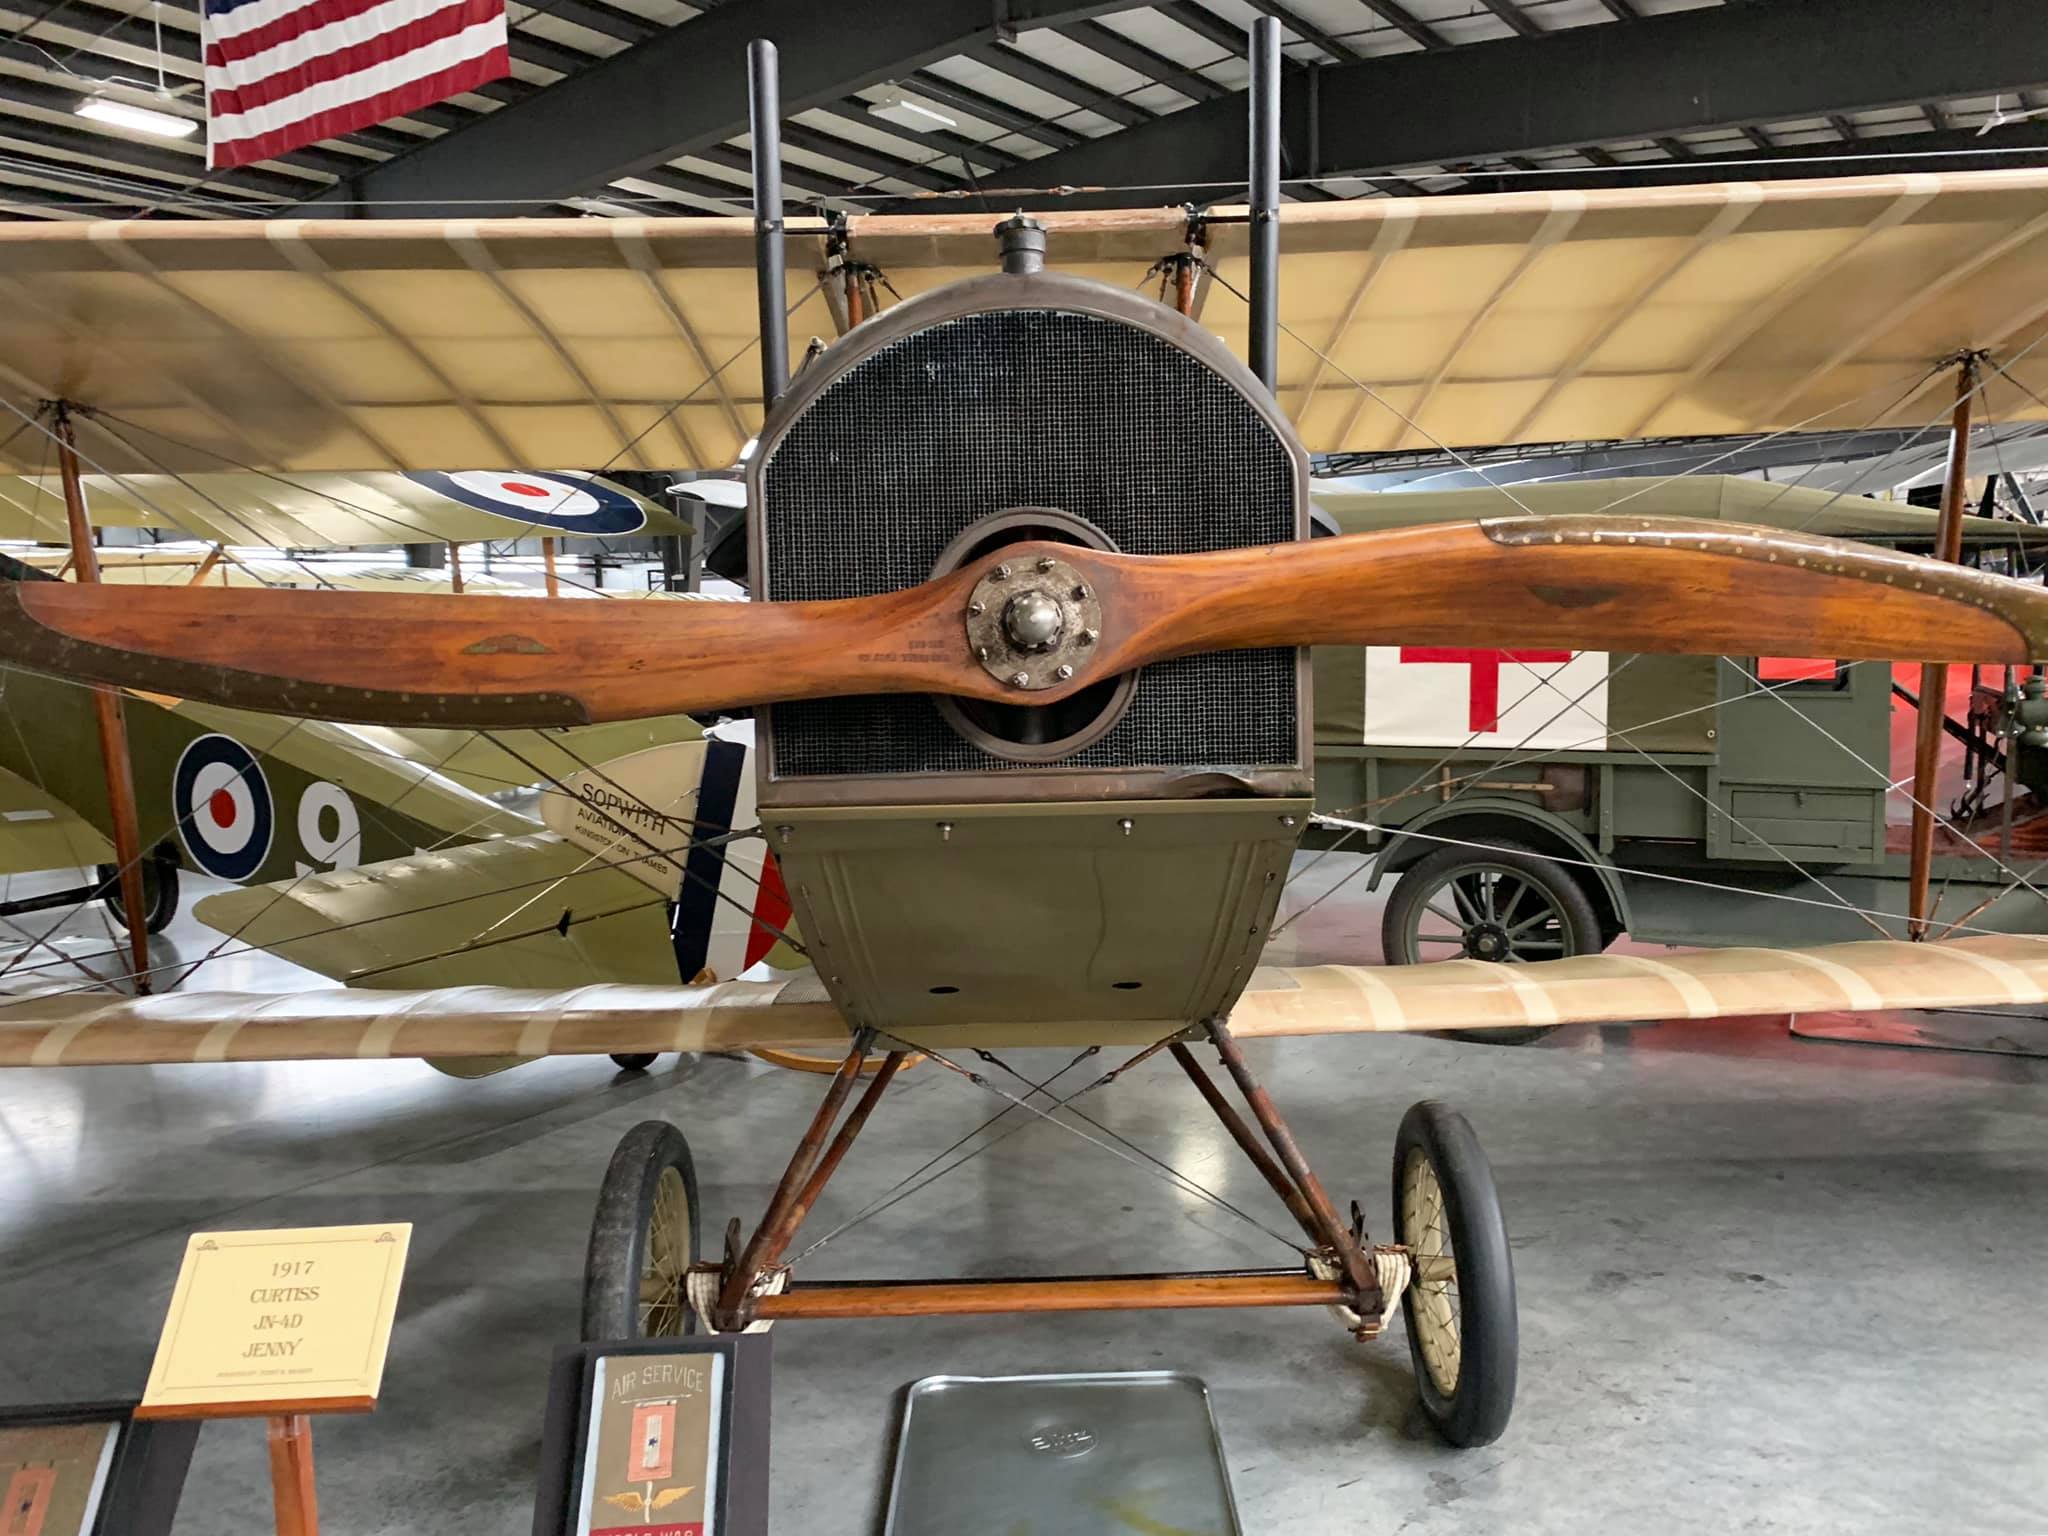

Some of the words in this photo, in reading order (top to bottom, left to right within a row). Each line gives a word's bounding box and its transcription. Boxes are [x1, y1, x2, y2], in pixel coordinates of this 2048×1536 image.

[583, 783, 664, 835] SOPWITH
[295, 781, 361, 877] 9
[272, 1260, 315, 1278] 1917
[250, 1286, 320, 1303] CURTISS
[253, 1313, 303, 1330] JN-4D
[242, 1338, 304, 1358] JENNY
[611, 1371, 636, 1400] AIR
[642, 1364, 704, 1393] SERVICE
